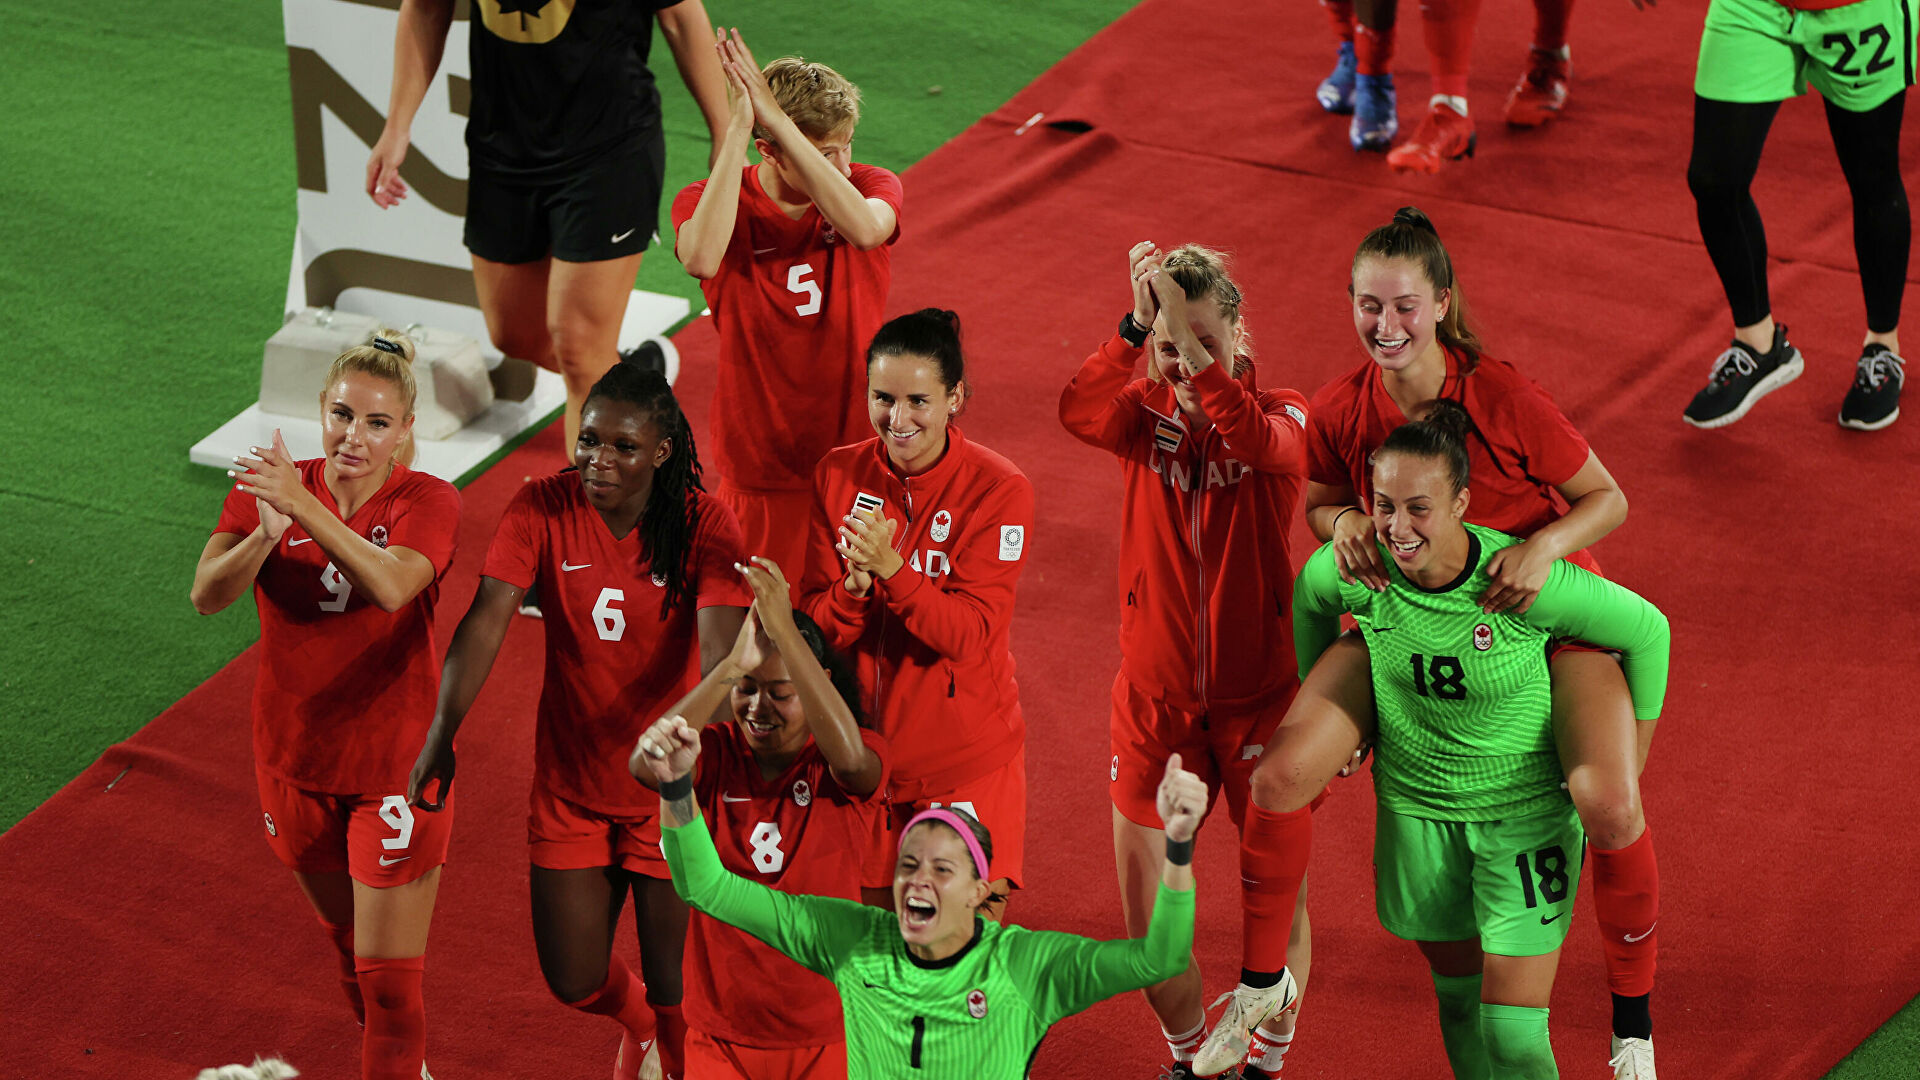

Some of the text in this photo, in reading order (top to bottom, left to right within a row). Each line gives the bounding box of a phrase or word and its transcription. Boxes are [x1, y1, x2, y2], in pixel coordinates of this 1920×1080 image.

[1822, 23, 1895, 76] 22
[787, 263, 821, 317] 5
[318, 561, 352, 612] 9
[592, 588, 626, 641] 6
[1410, 653, 1467, 700] 18
[379, 795, 414, 849] 9
[750, 822, 784, 873] 8
[1515, 845, 1569, 909] 18
[910, 1016, 925, 1069] 1
